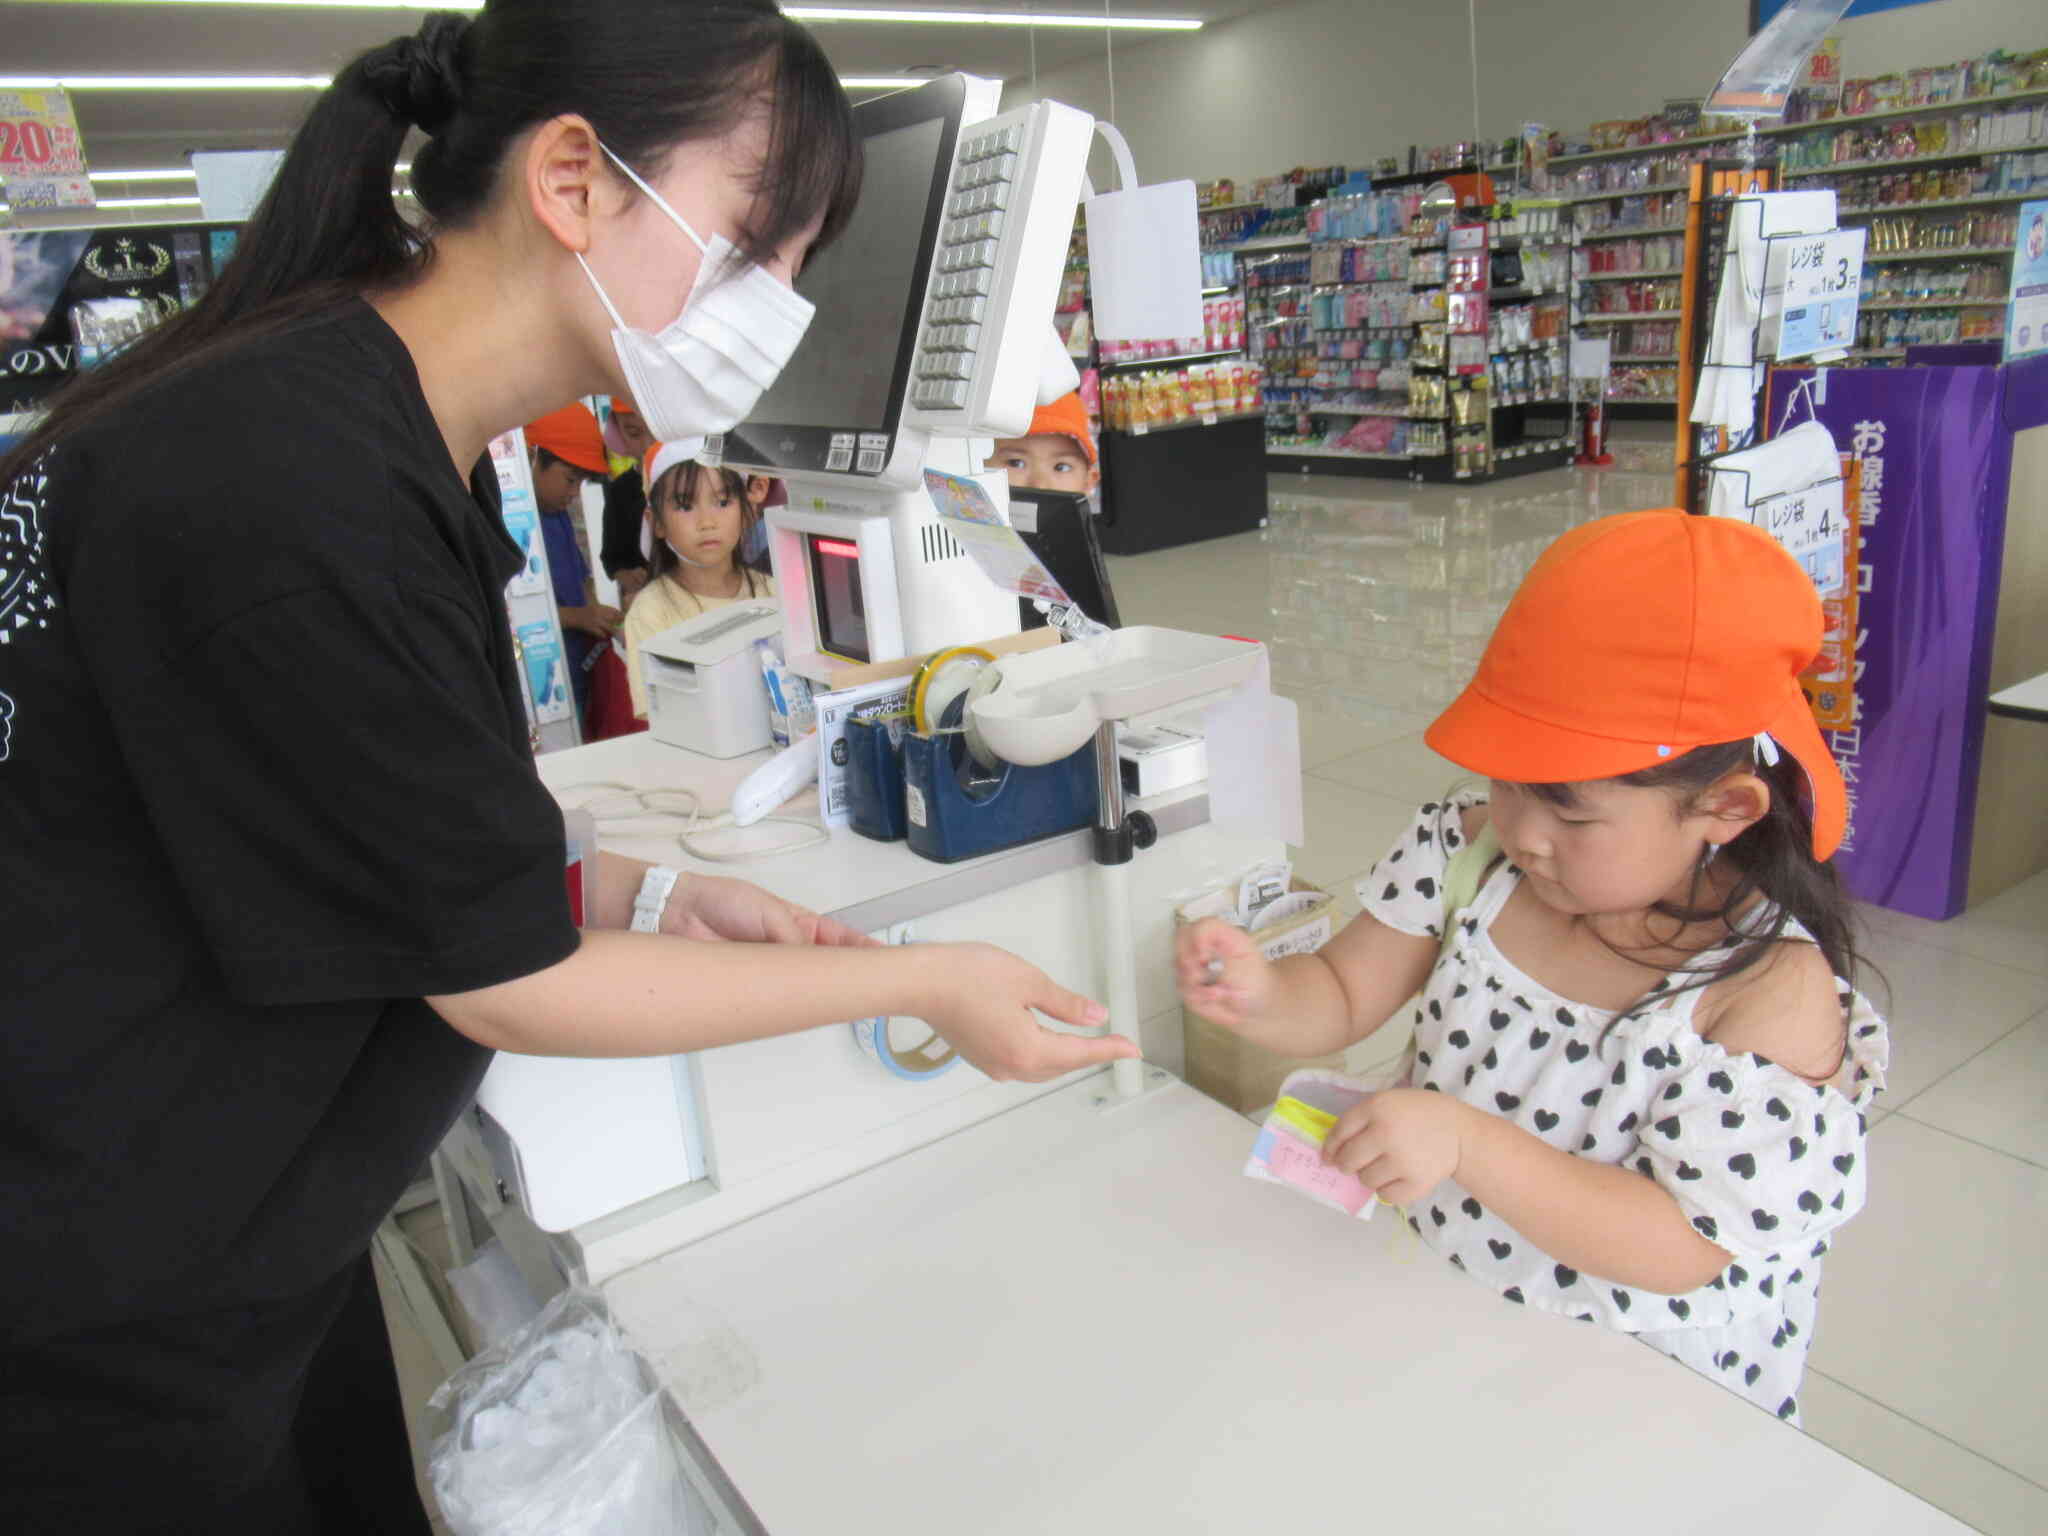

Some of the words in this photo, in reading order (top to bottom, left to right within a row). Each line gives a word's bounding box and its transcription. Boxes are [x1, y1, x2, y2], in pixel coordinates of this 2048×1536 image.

[1791, 240, 1825, 270] レジ袋
[1773, 500, 1805, 529] レジ袋
